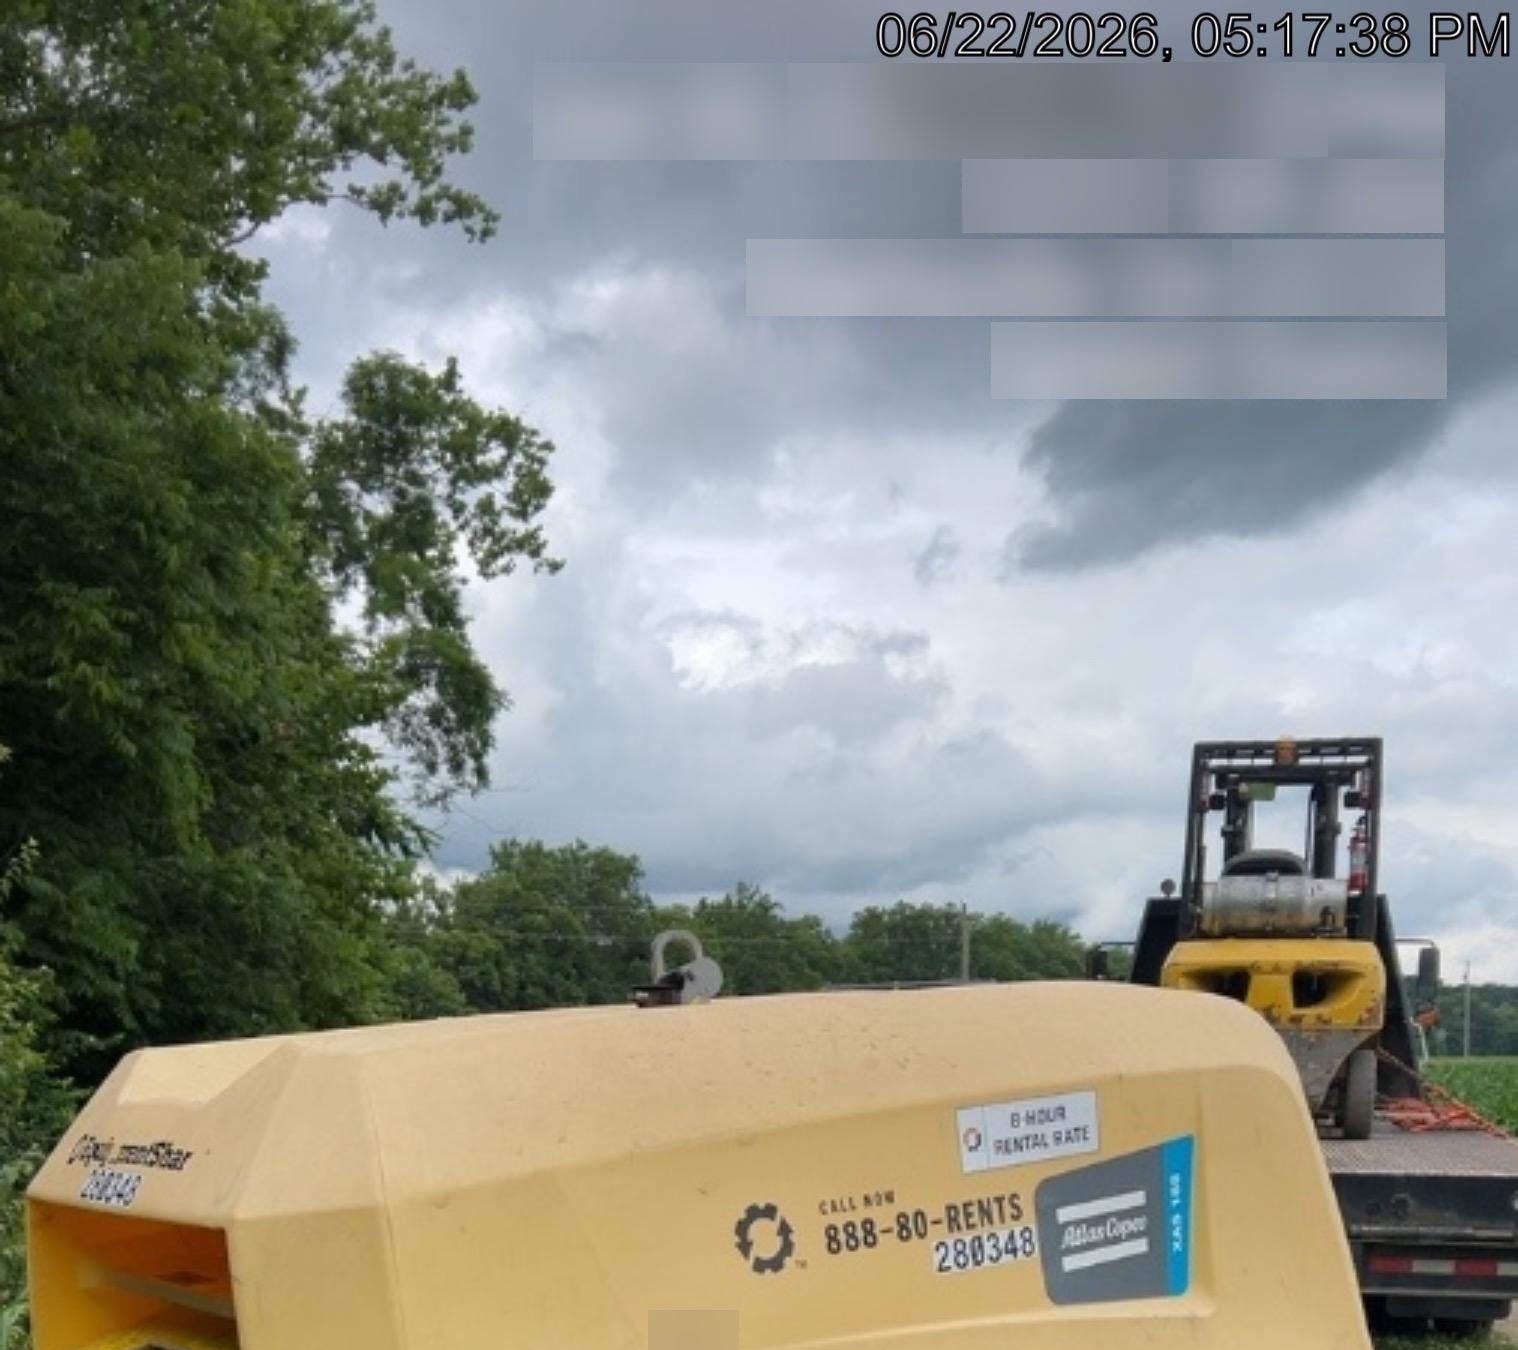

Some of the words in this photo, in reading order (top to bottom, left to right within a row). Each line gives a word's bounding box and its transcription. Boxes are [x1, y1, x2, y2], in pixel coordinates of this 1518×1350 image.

[1010, 1106, 1066, 1128] 8-HOUR
[993, 1132, 1049, 1155] RENTAL
[1052, 1125, 1089, 1146] RATE
[818, 1197, 857, 1216] CALL
[863, 1191, 895, 1208] NOW
[824, 1193, 1024, 1255] 888-80-RENTS
[1061, 1223, 1105, 1249] Atlas
[1106, 1215, 1147, 1240] Copco
[935, 1226, 1036, 1273] 280348
